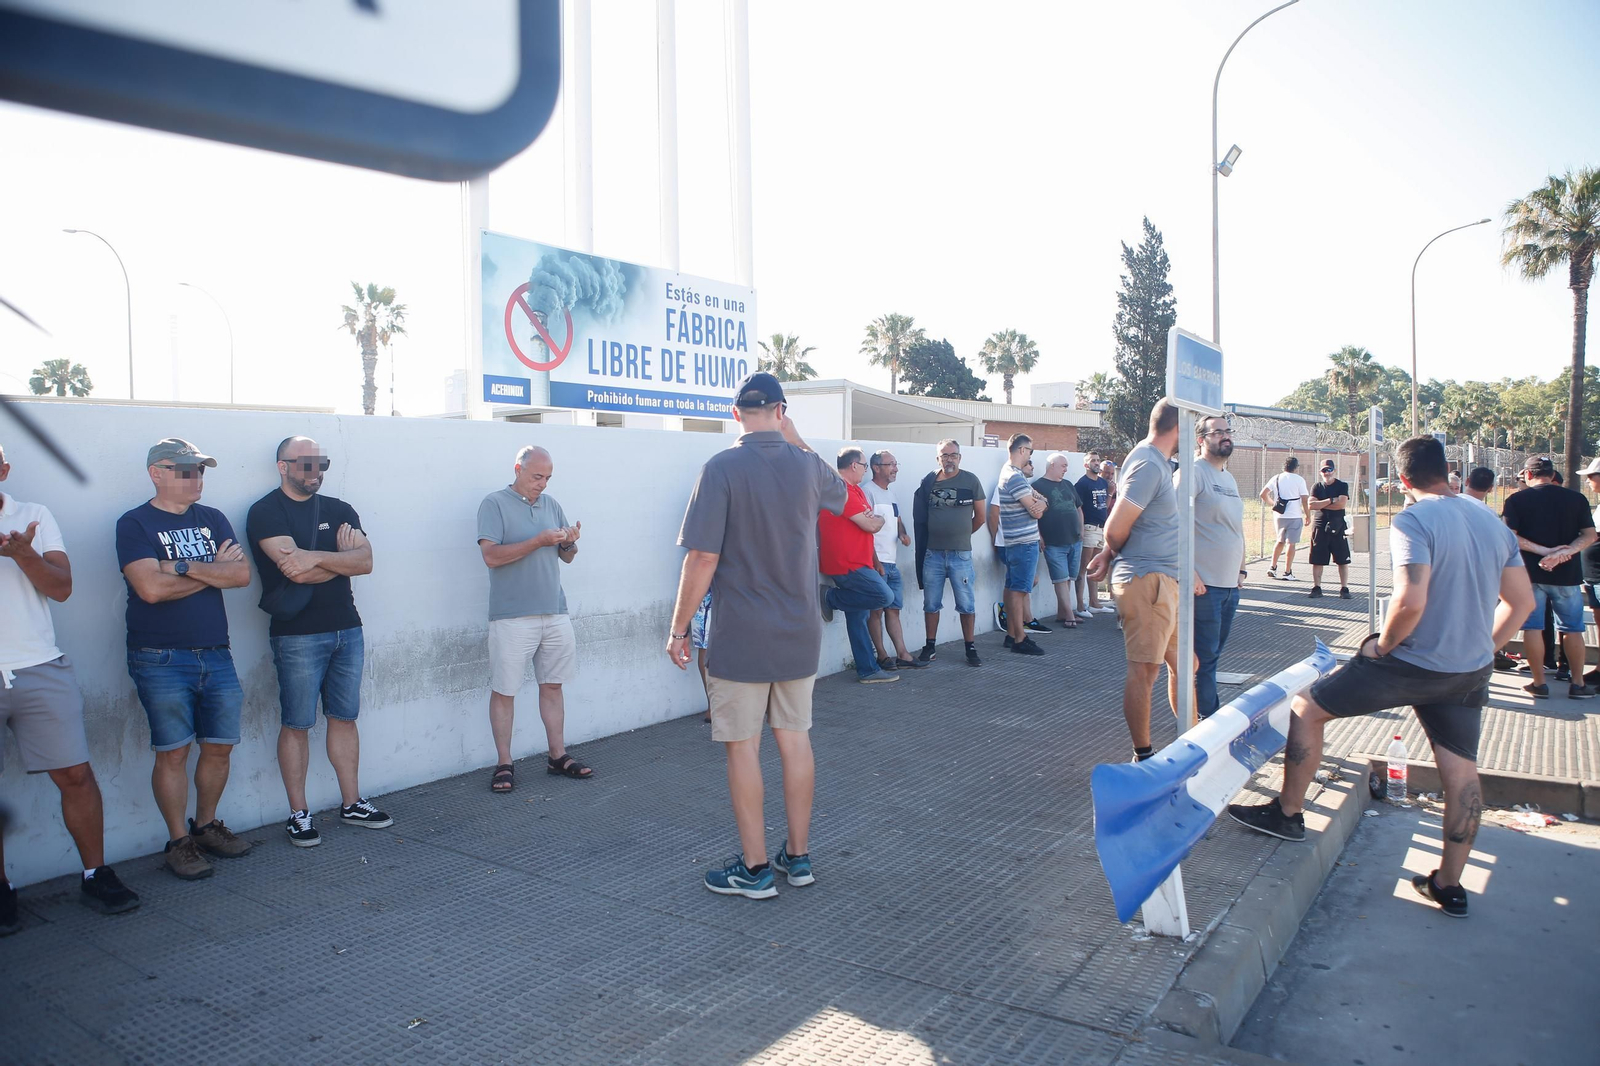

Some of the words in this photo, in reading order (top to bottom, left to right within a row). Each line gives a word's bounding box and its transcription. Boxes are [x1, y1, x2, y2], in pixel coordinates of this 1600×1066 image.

[666, 282, 700, 305] Estás
[705, 295, 719, 309] en
[723, 298, 745, 313] una
[666, 304, 748, 352] FÁBRICA
[588, 338, 653, 380] LIBRE
[661, 348, 686, 384] DE
[1193, 365, 1220, 386] BARRIOS
[491, 383, 524, 398] ACERINOX
[587, 390, 633, 406] Prohibido
[635, 393, 661, 408] fumar
[663, 400, 674, 409] en
[676, 397, 695, 411] toda
[697, 399, 705, 412] la
[706, 400, 734, 413] factorí
[158, 527, 202, 545] MOVE
[165, 540, 218, 560] FASTER
